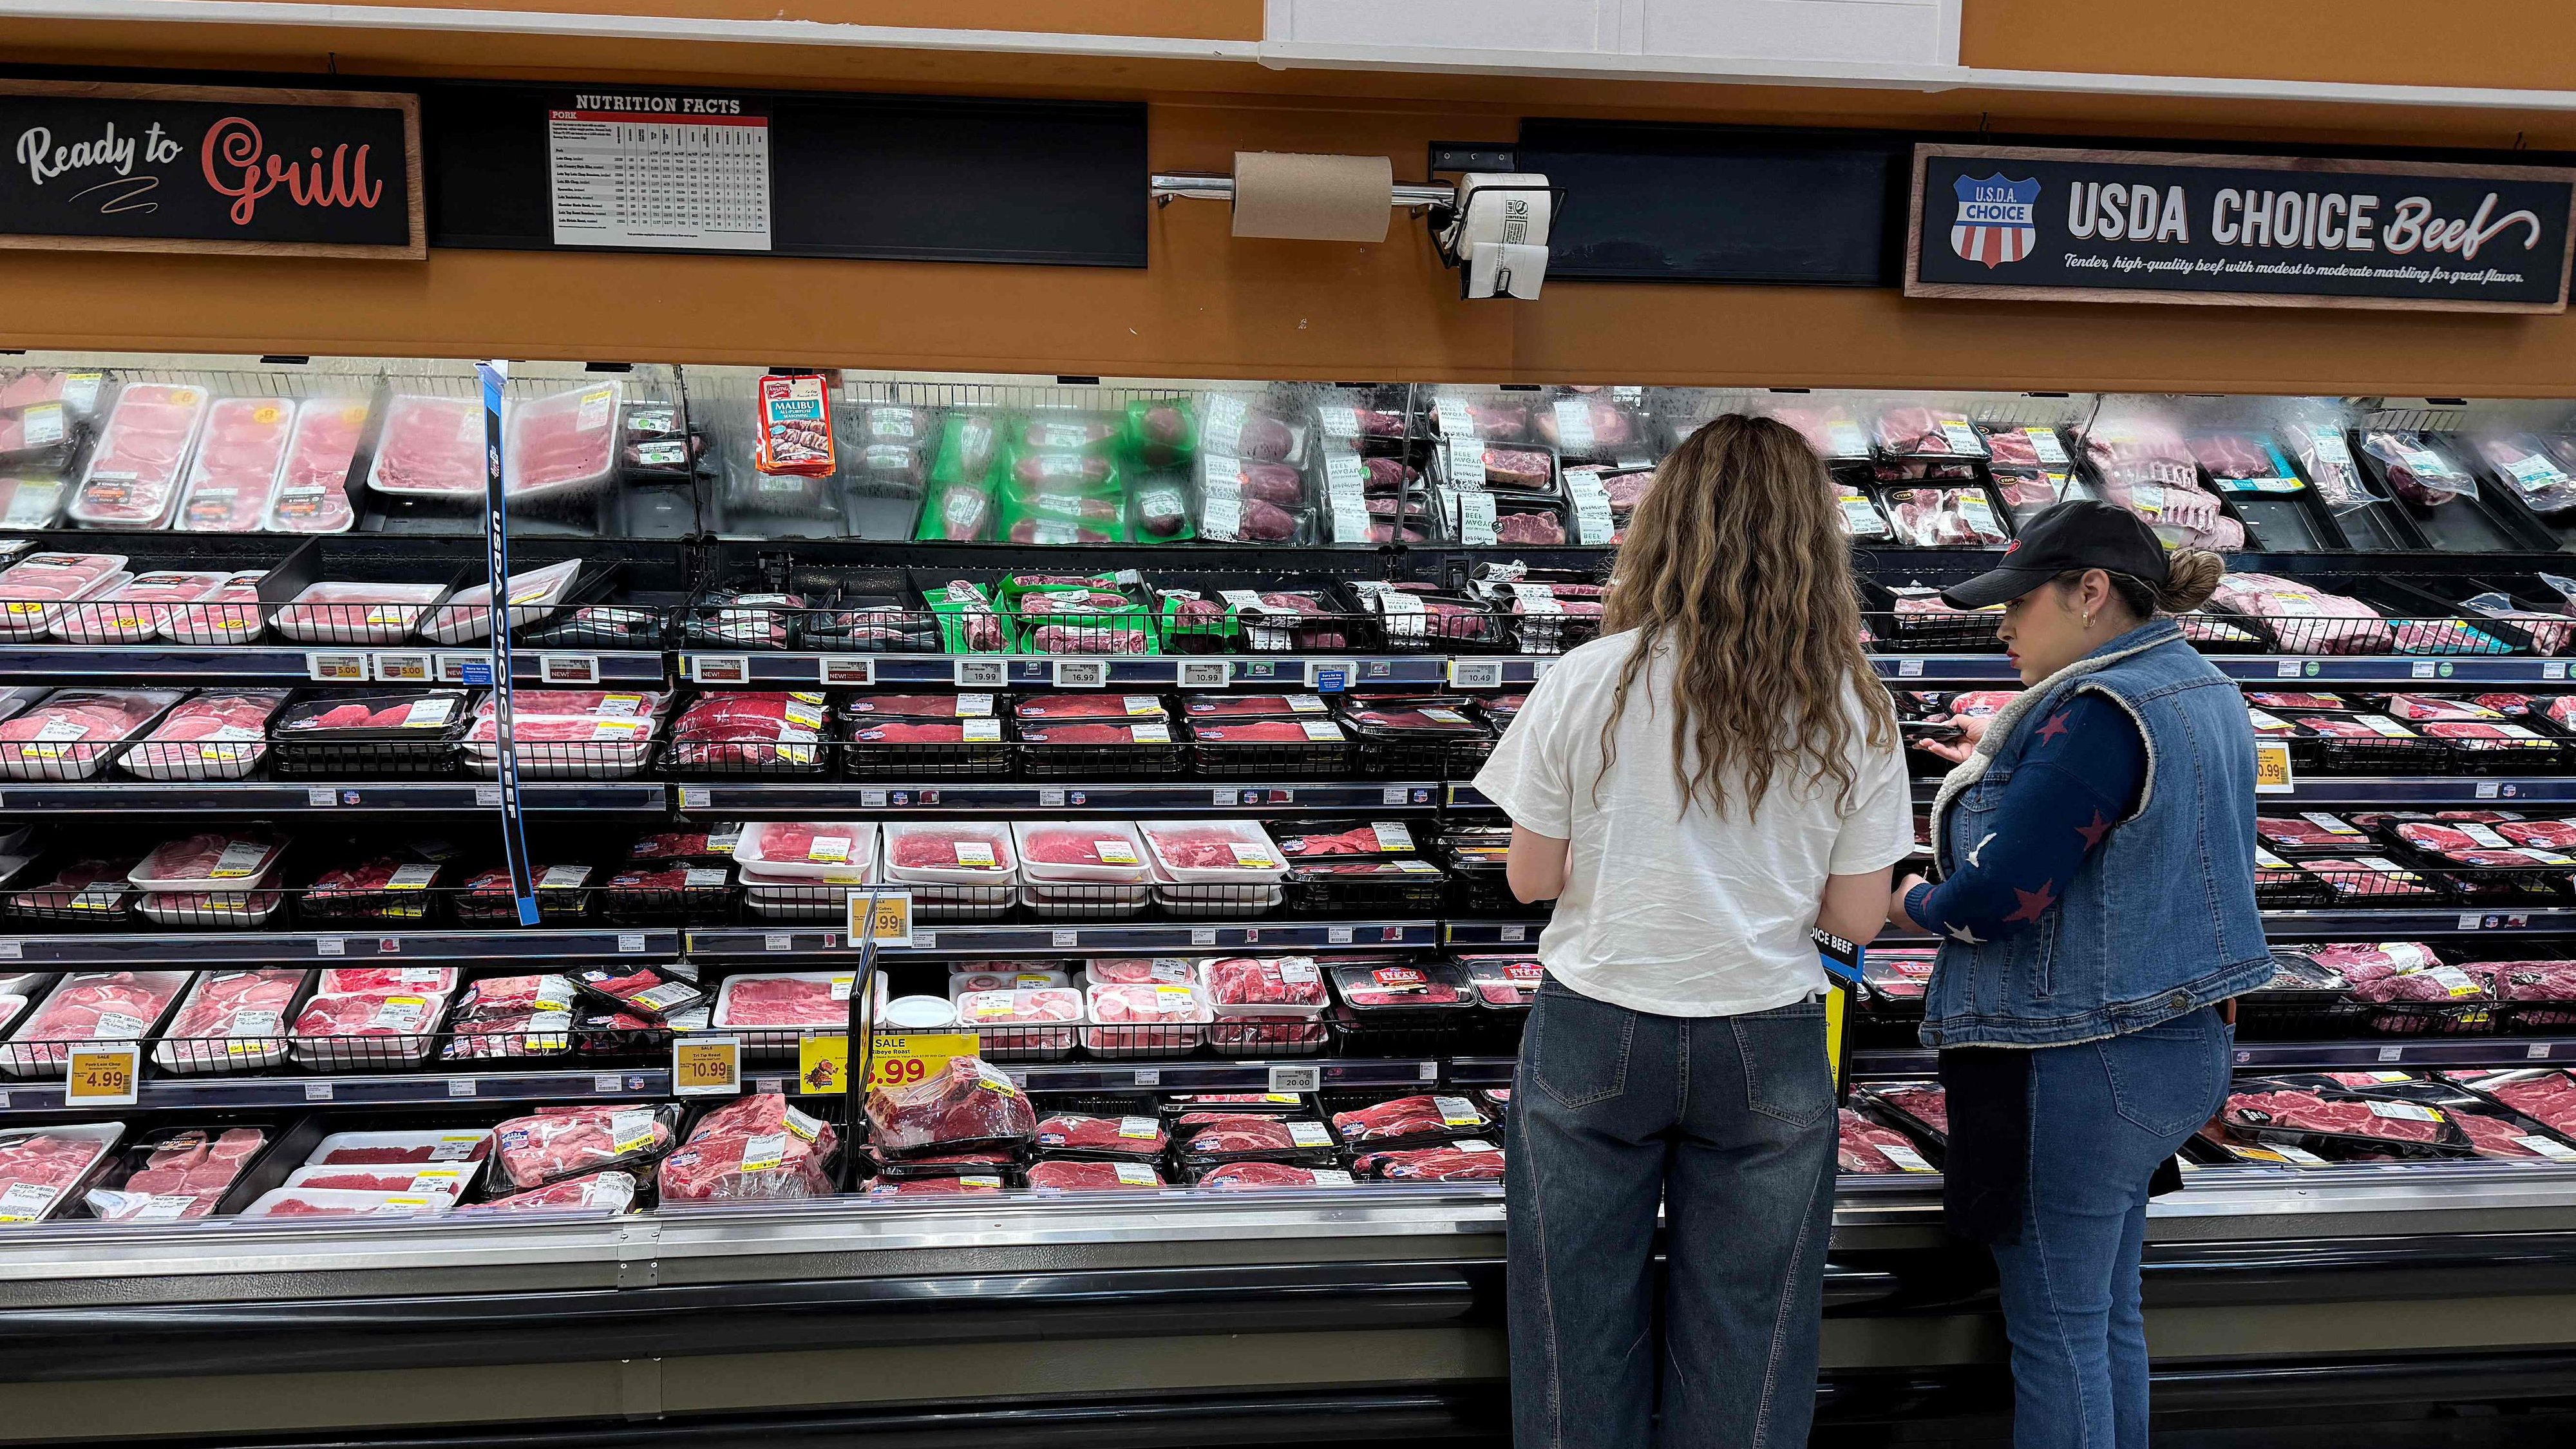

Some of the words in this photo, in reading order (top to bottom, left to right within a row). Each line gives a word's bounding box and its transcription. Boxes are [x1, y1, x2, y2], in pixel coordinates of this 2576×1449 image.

[576, 95, 677, 112] NUTRITION
[683, 98, 741, 115] FACTS
[553, 110, 577, 120] PORK
[16, 122, 135, 185] Ready
[144, 122, 184, 164] to
[201, 117, 383, 225] Grill
[1975, 187, 2017, 204] U.S.D.A.
[1966, 205, 2025, 221] CHOICE
[2068, 181, 2189, 243] USDA
[2211, 187, 2379, 252] CHOICE
[2383, 192, 2541, 261] Beef
[2064, 252, 2110, 270] Tender,
[2112, 254, 2194, 275] high-quality
[2195, 260, 2224, 275] beef
[2225, 261, 2253, 273] with
[2255, 261, 2302, 275] modest
[2302, 263, 2315, 275] to
[2316, 265, 2372, 277] moderate
[2373, 267, 2430, 283] marbling
[2429, 268, 2450, 283] for
[2450, 270, 2483, 284] great
[2481, 270, 2524, 285] flavor.
[775, 401, 815, 410] MALIBU
[492, 510, 502, 596] USDA
[497, 608, 509, 739] CHOICE
[2258, 764, 2280, 777] 0.99
[502, 750, 517, 819] BEEF
[876, 915, 898, 929] .99
[1831, 934, 1853, 955] BEEF
[875, 1039, 905, 1047] SALE
[692, 1062, 726, 1077] 10.99
[87, 1072, 123, 1087] 4.99
